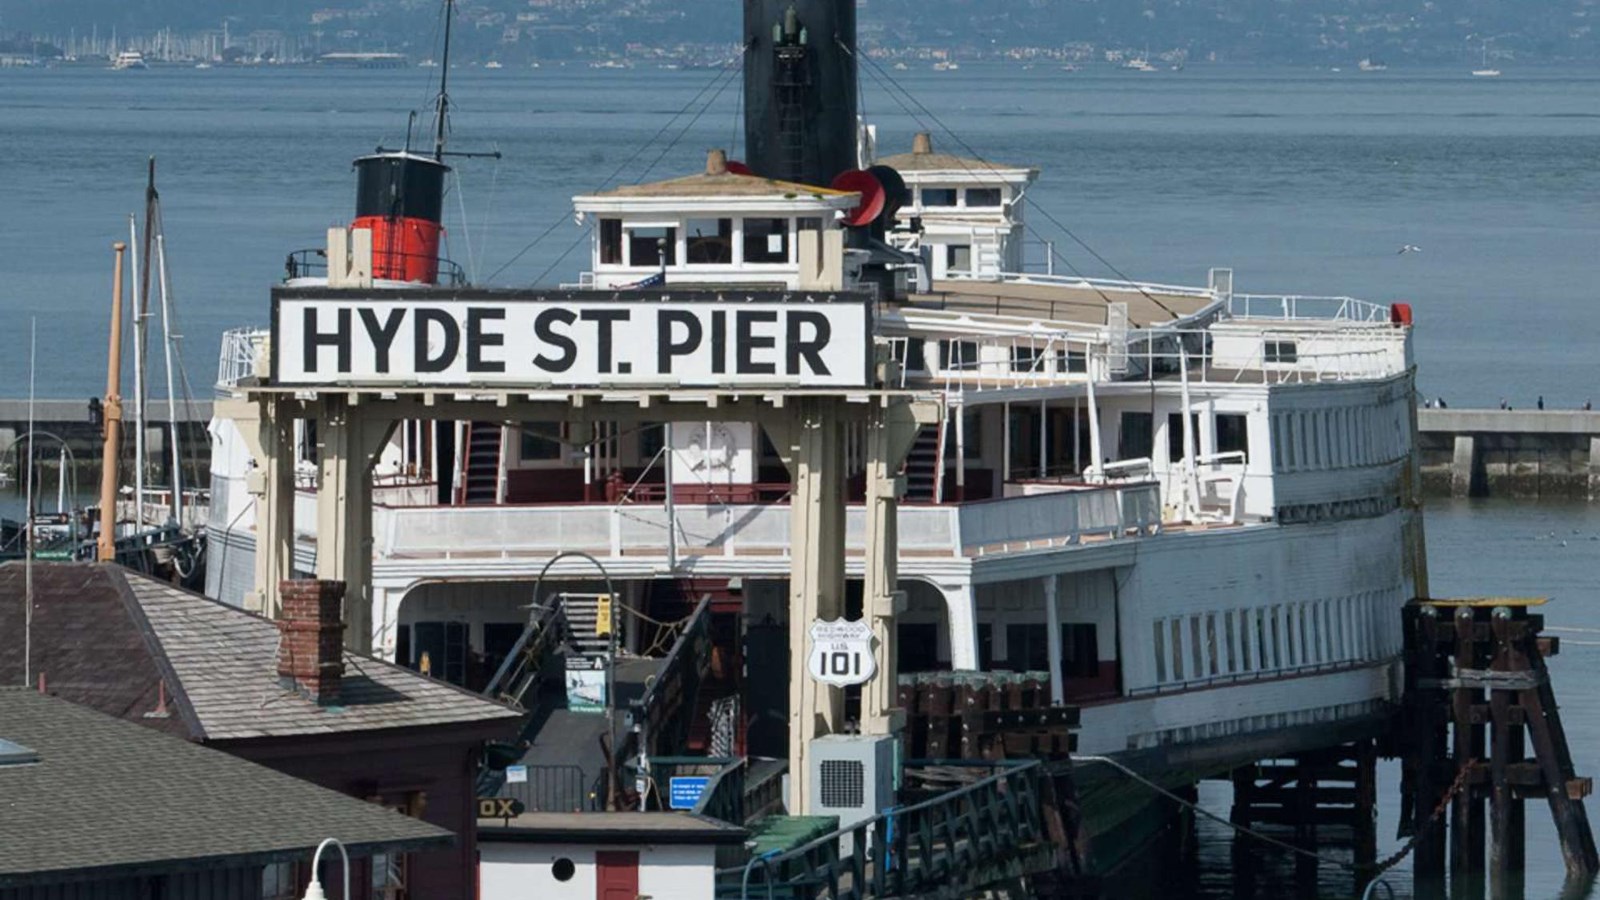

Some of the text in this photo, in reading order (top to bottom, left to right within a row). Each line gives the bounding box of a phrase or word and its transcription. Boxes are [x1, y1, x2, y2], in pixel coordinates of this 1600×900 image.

[303, 307, 831, 376] HYDE ST. PIER
[821, 652, 860, 675] 101
